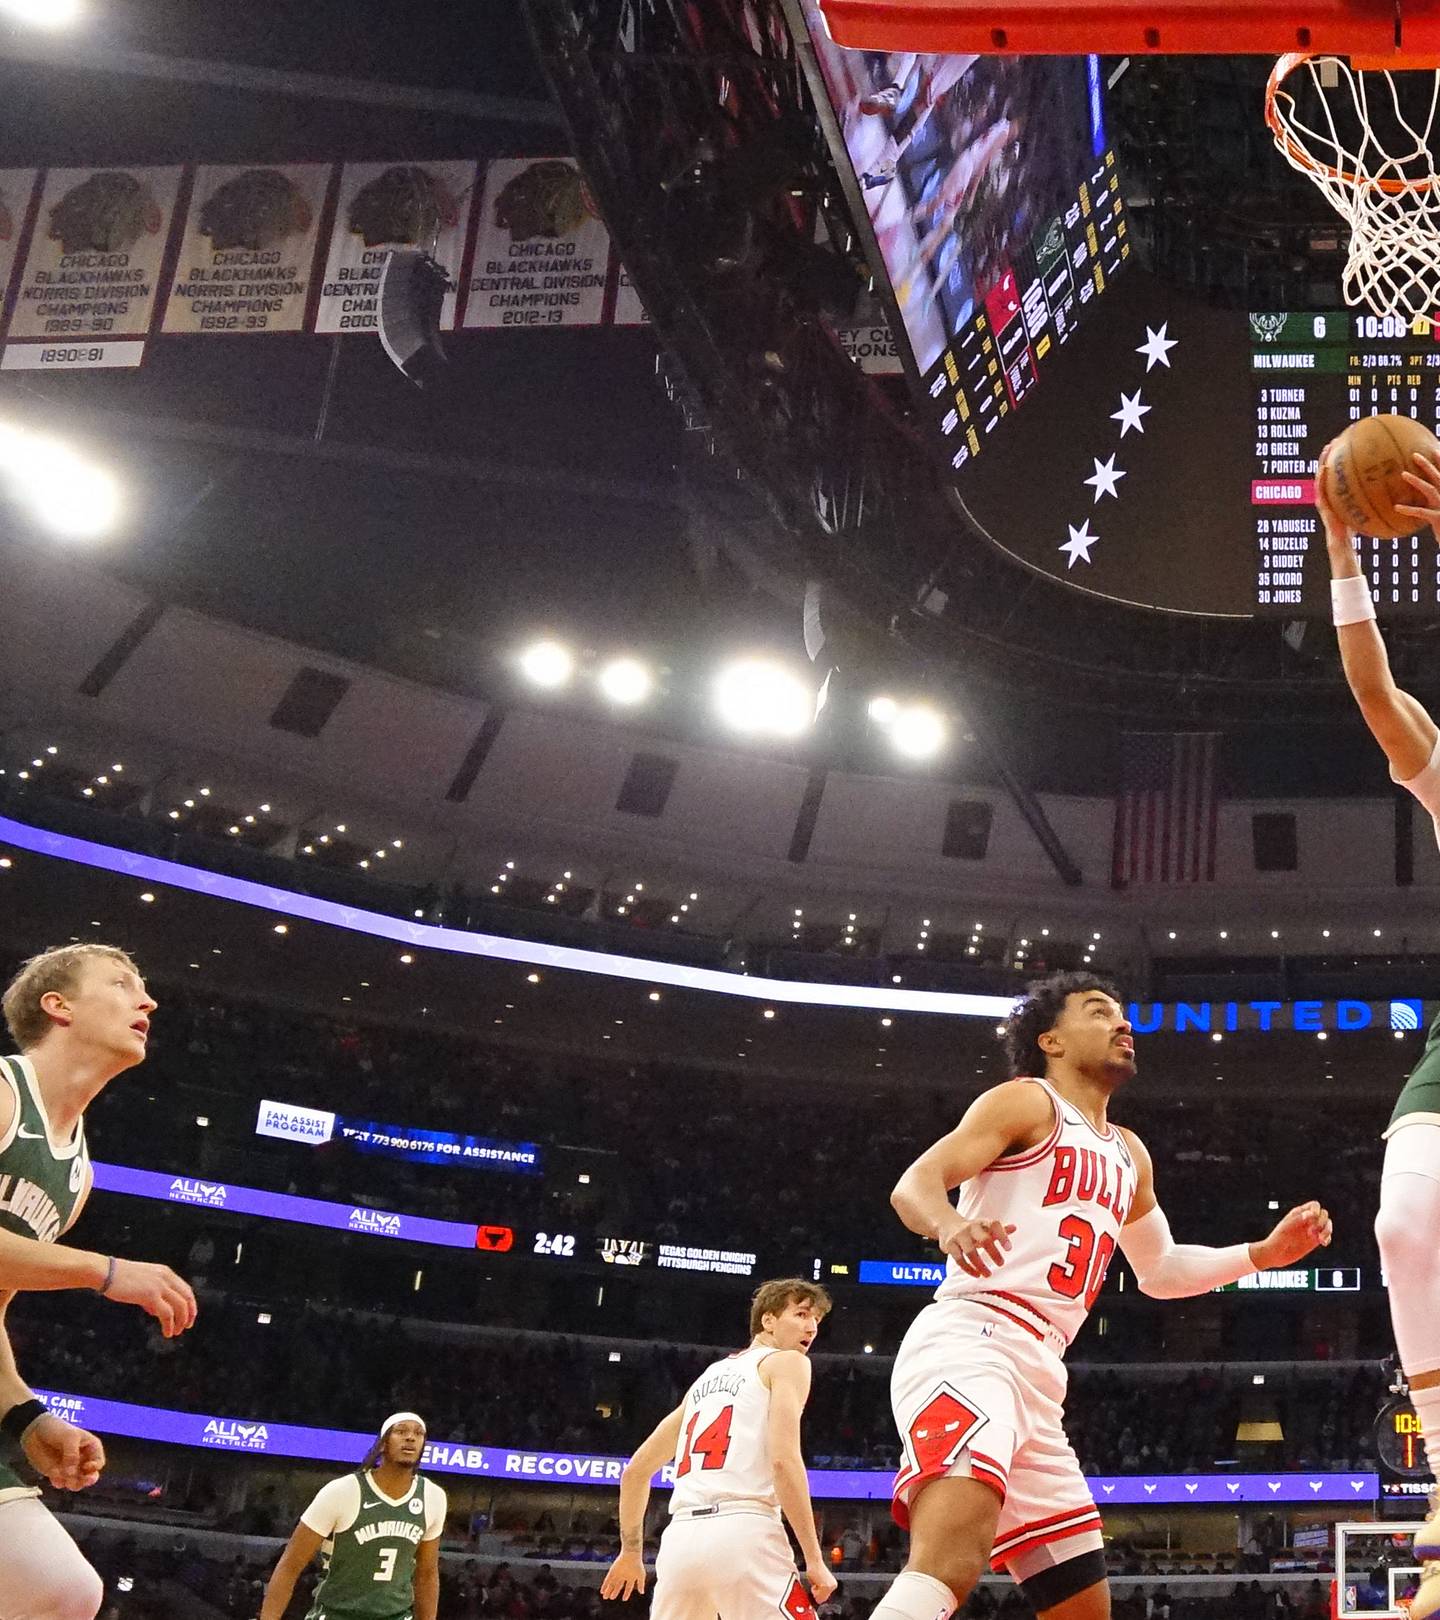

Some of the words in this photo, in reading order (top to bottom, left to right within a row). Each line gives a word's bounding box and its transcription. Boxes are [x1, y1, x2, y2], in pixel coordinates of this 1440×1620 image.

[508, 243, 576, 257] CHICAGO
[59, 255, 129, 268] CHICAGO
[213, 251, 281, 265] CHICAGO
[486, 258, 593, 274] BLACKHAWKS
[35, 269, 144, 284] BLACKHAWKS
[189, 267, 296, 281] BLACKHAWKS
[175, 284, 236, 297] NORRIS
[239, 282, 303, 296] DIVISION
[471, 277, 539, 291] CENTRAL
[543, 274, 604, 289] DIVISION
[23, 287, 78, 300] NORRIS
[84, 284, 150, 299] DIVISION
[489, 292, 580, 307] CHAMPIONS
[36, 301, 129, 316] CHAMPIONS
[191, 299, 284, 313] CHAMPIONS
[502, 310, 563, 324] 2012-13
[1313, 316, 1326, 339] 6
[1355, 315, 1406, 338] 10:08
[1253, 354, 1315, 368] MILWAUKEE
[1362, 354, 1377, 368] 2/3
[1426, 354, 1440, 367] 2/3
[1261, 388, 1268, 402] 3
[1270, 388, 1305, 402] TURNER
[1349, 388, 1360, 402] 01
[1257, 407, 1268, 420] 18
[1270, 406, 1301, 420] KUZMA
[1257, 425, 1268, 438] 13
[1270, 424, 1308, 438] ROLLINS
[1256, 442, 1268, 456] 20
[1270, 442, 1299, 456] GREEN
[1262, 460, 1268, 474] 7
[1271, 460, 1306, 474] PORTER
[1255, 485, 1302, 499] CHICAGO
[1257, 519, 1269, 533] 28
[1271, 519, 1316, 533] YABUSELE
[1259, 537, 1269, 550] 14
[1272, 537, 1309, 550] BUZELIS
[1263, 555, 1270, 568] 3
[1272, 555, 1304, 568] GIDDEY
[1258, 572, 1270, 586] 35
[1272, 572, 1302, 586] OKORO
[1258, 590, 1270, 603] 30
[1272, 590, 1302, 603] JONES
[1128, 1000, 1373, 1033] UNITED
[266, 1110, 288, 1122] FAN
[290, 1114, 326, 1128] ASSIST
[265, 1119, 325, 1137] PROGRAM
[371, 1133, 389, 1146] 773
[390, 1136, 409, 1149] 900
[410, 1138, 435, 1152] 6176
[436, 1143, 460, 1155] FOR
[463, 1145, 535, 1163] ASSISTANCE
[533, 1232, 575, 1257] 2:42
[659, 1245, 687, 1258] VEGAS
[687, 1247, 720, 1261] GOLDEN
[720, 1250, 756, 1265] KNIGHTS
[657, 1256, 710, 1271] PITTSBURGH
[710, 1261, 752, 1276] PENGUINS
[1047, 1213, 1115, 1313] 30
[813, 1269, 820, 1280] 5
[892, 1267, 943, 1281] ULTRA
[1237, 1270, 1309, 1289] MILWAUKEE
[692, 1374, 746, 1405] BUZELIS
[51, 1397, 85, 1410] CARE.
[202, 1436, 266, 1450] HEALTHCARE
[676, 1404, 734, 1479] 14
[1407, 1435, 1413, 1469] 1
[420, 1445, 490, 1470] EHAB.
[505, 1454, 630, 1479] RECOVER
[354, 1520, 424, 1545] MILWAUKEE
[373, 1548, 398, 1581] 3
